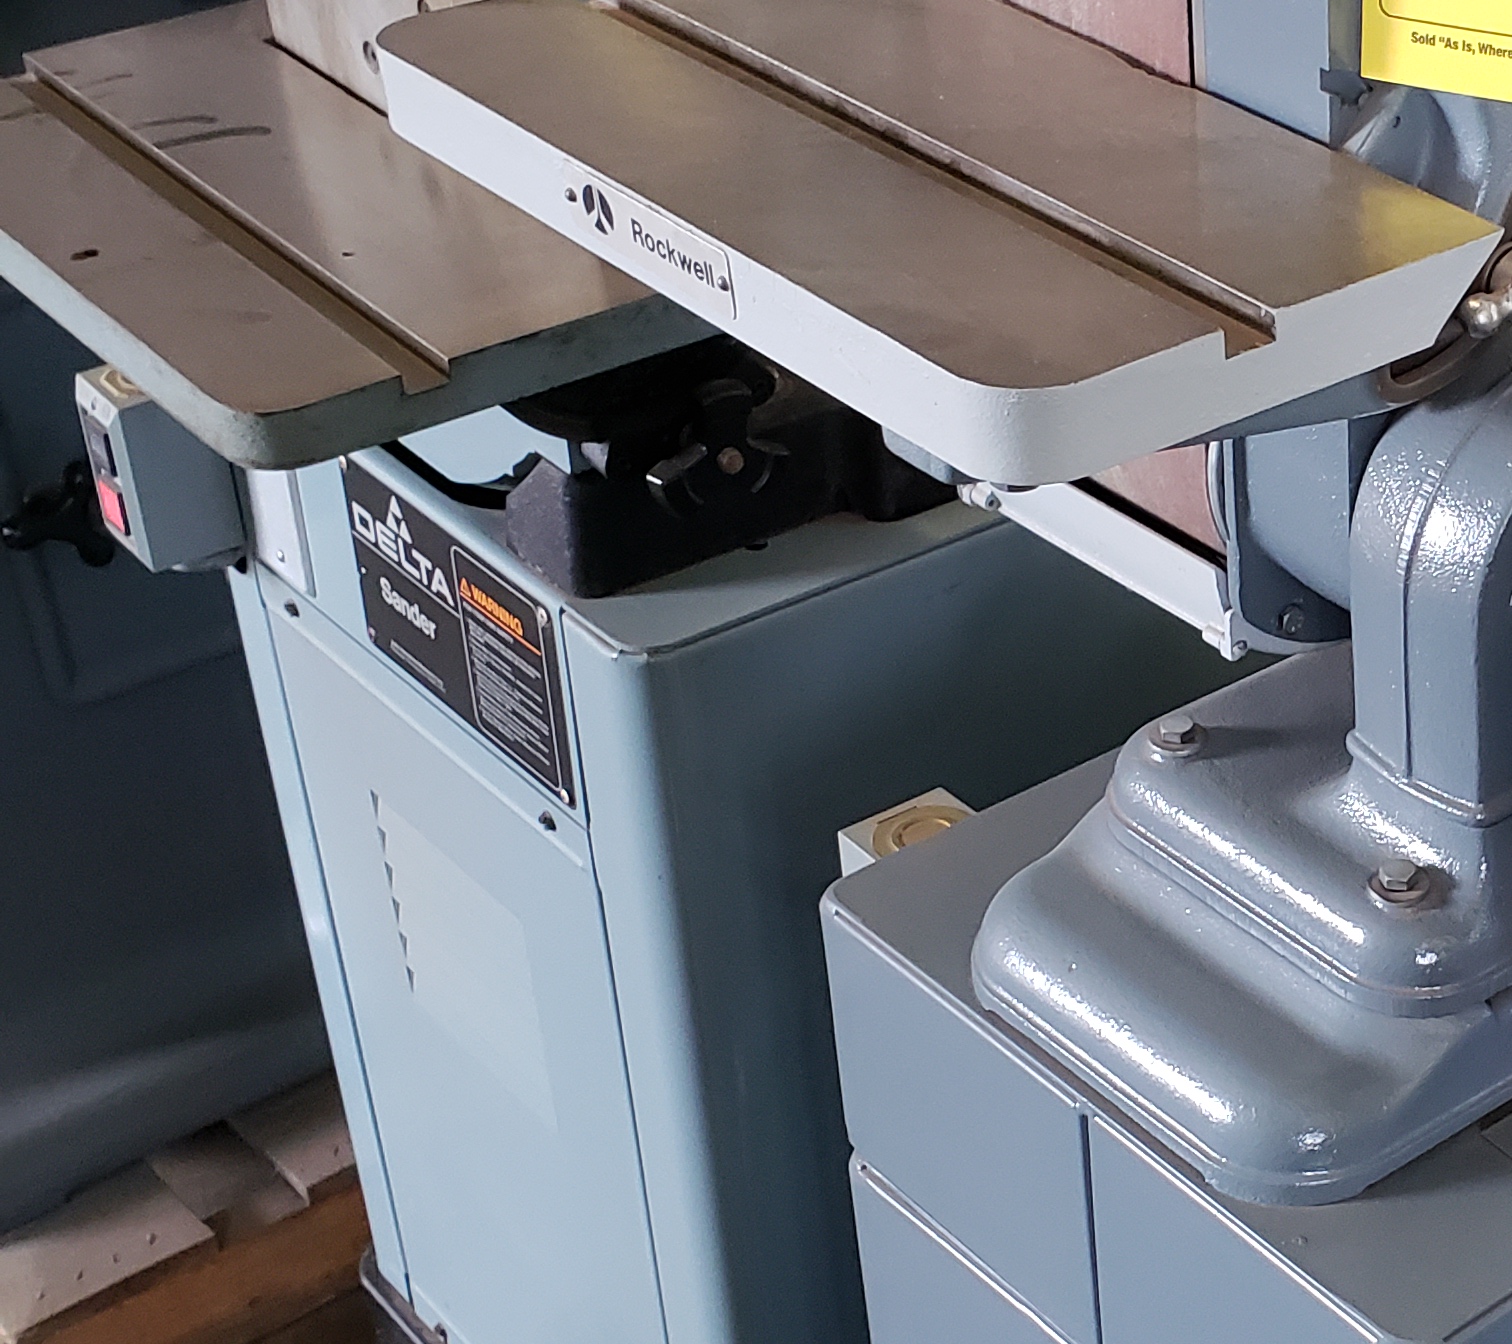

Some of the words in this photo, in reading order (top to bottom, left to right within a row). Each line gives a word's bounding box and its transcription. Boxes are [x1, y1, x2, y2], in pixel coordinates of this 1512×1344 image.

[1410, 31, 1436, 47] Sold
[1461, 40, 1476, 56] Is,
[630, 217, 716, 289] Rockwell
[351, 500, 455, 607] DELTA
[379, 576, 437, 640] Sander
[471, 583, 524, 637] WARNING
